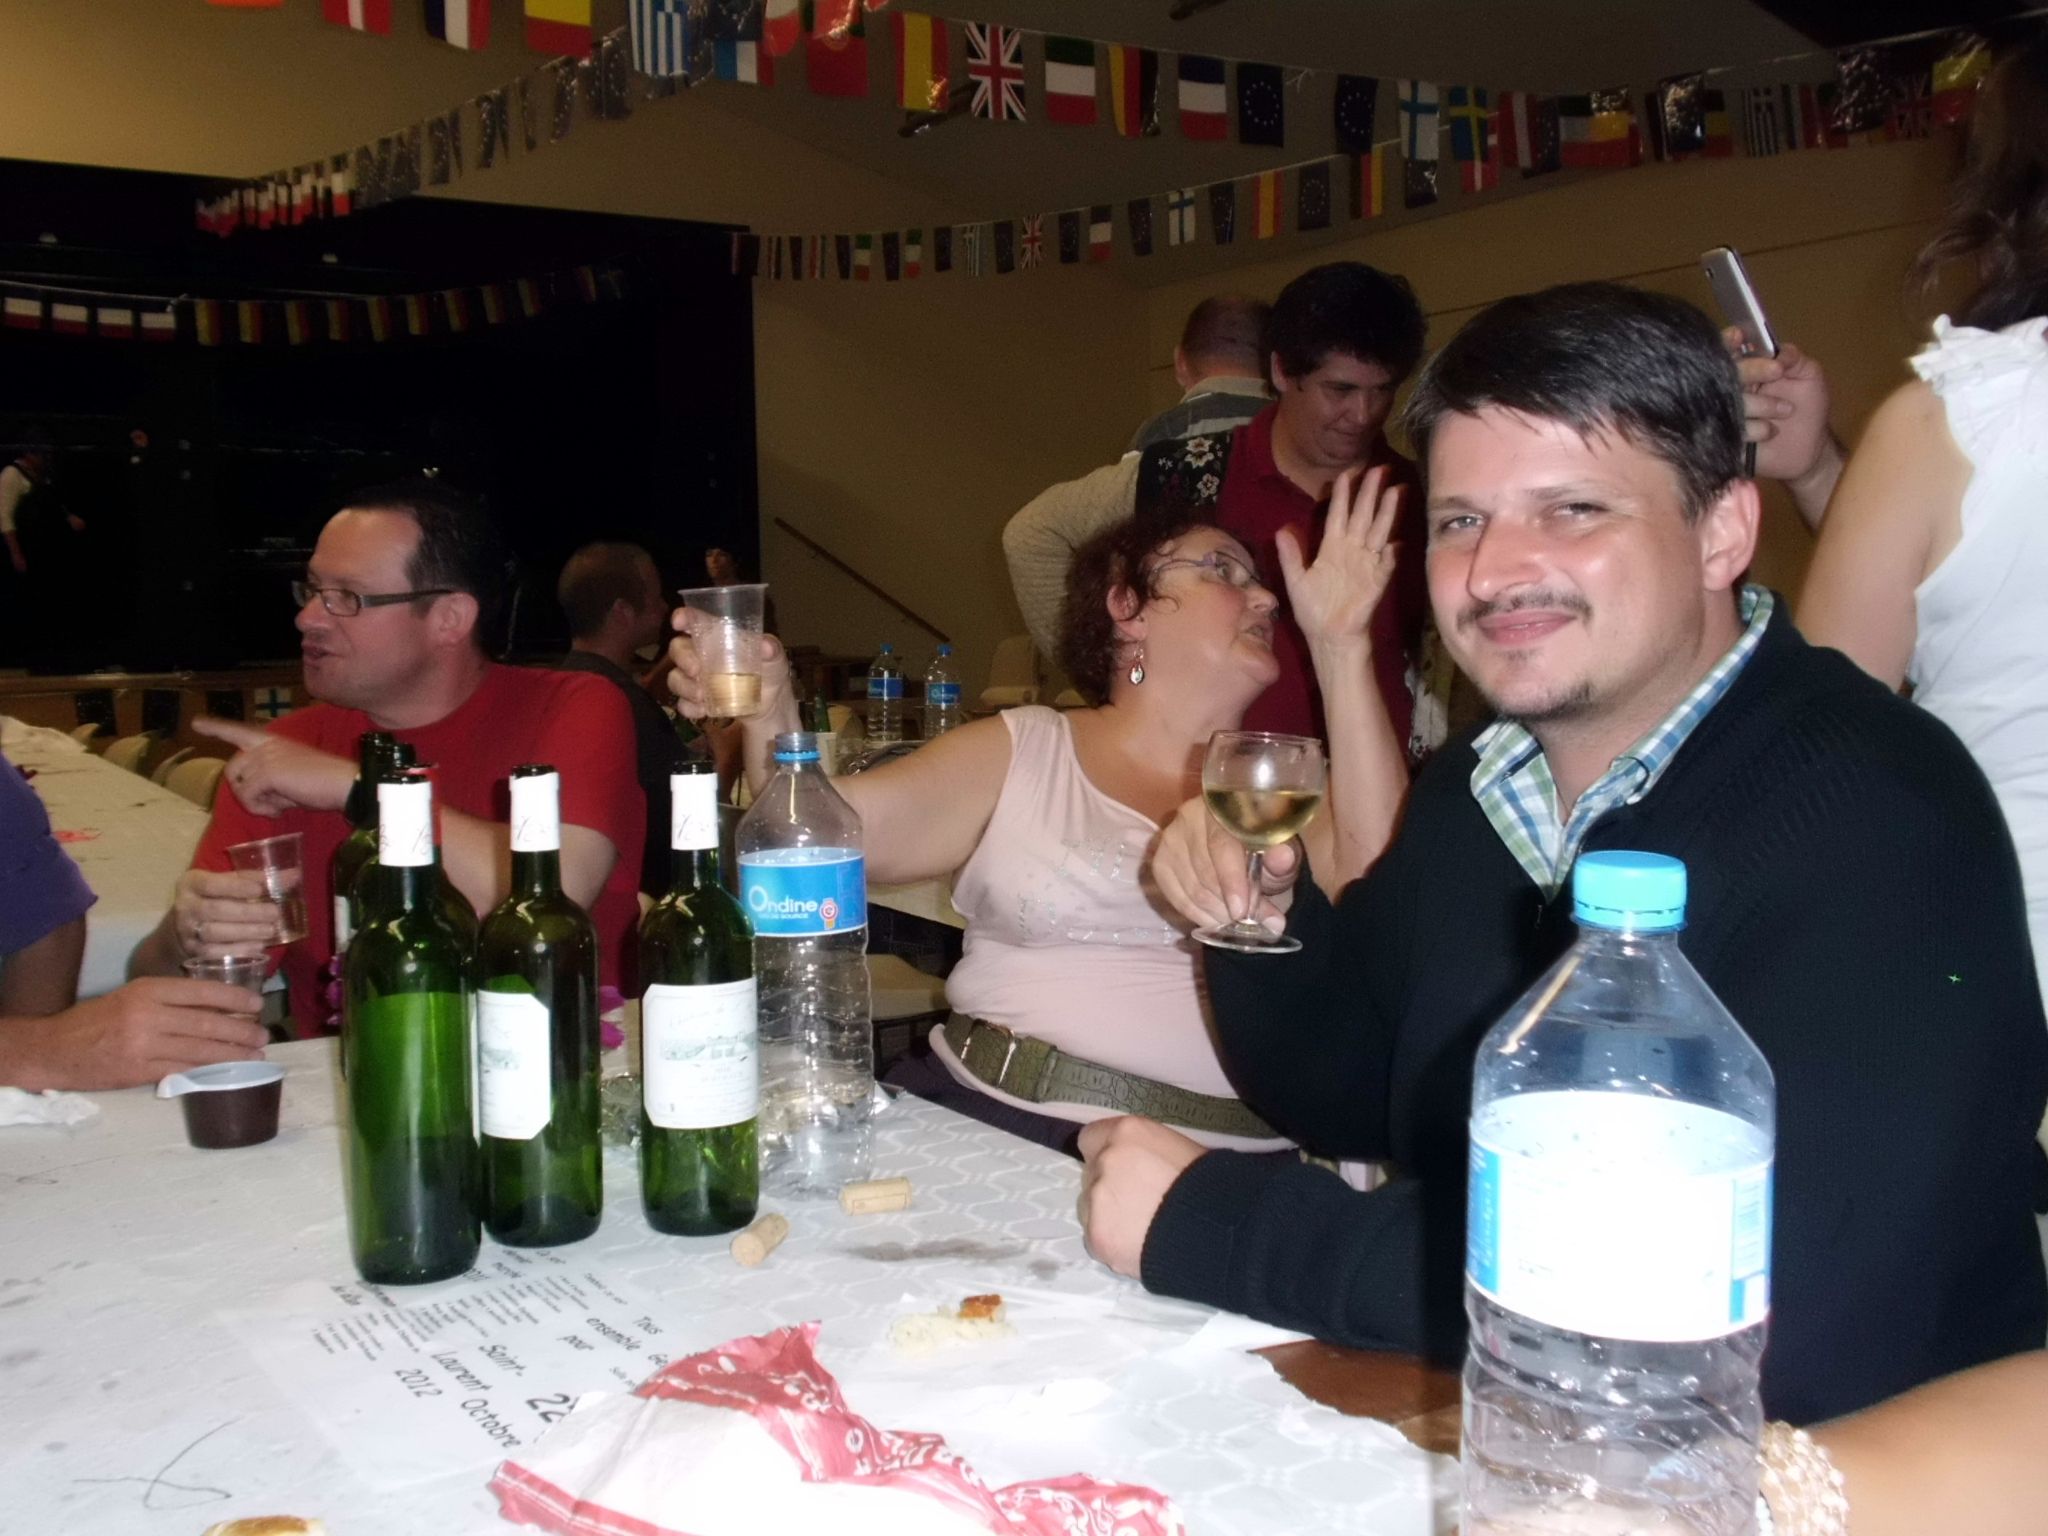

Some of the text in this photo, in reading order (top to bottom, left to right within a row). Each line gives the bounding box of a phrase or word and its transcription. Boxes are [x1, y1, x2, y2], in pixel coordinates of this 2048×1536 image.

[748, 885, 818, 912] Ondine
[586, 1318, 642, 1351] ensemble
[632, 1315, 663, 1335] Tous
[556, 1334, 594, 1350] pour
[430, 1350, 493, 1391] Laurent
[478, 1344, 527, 1377] Saint-
[394, 1368, 443, 1398] 2012
[460, 1398, 521, 1448] Octobre
